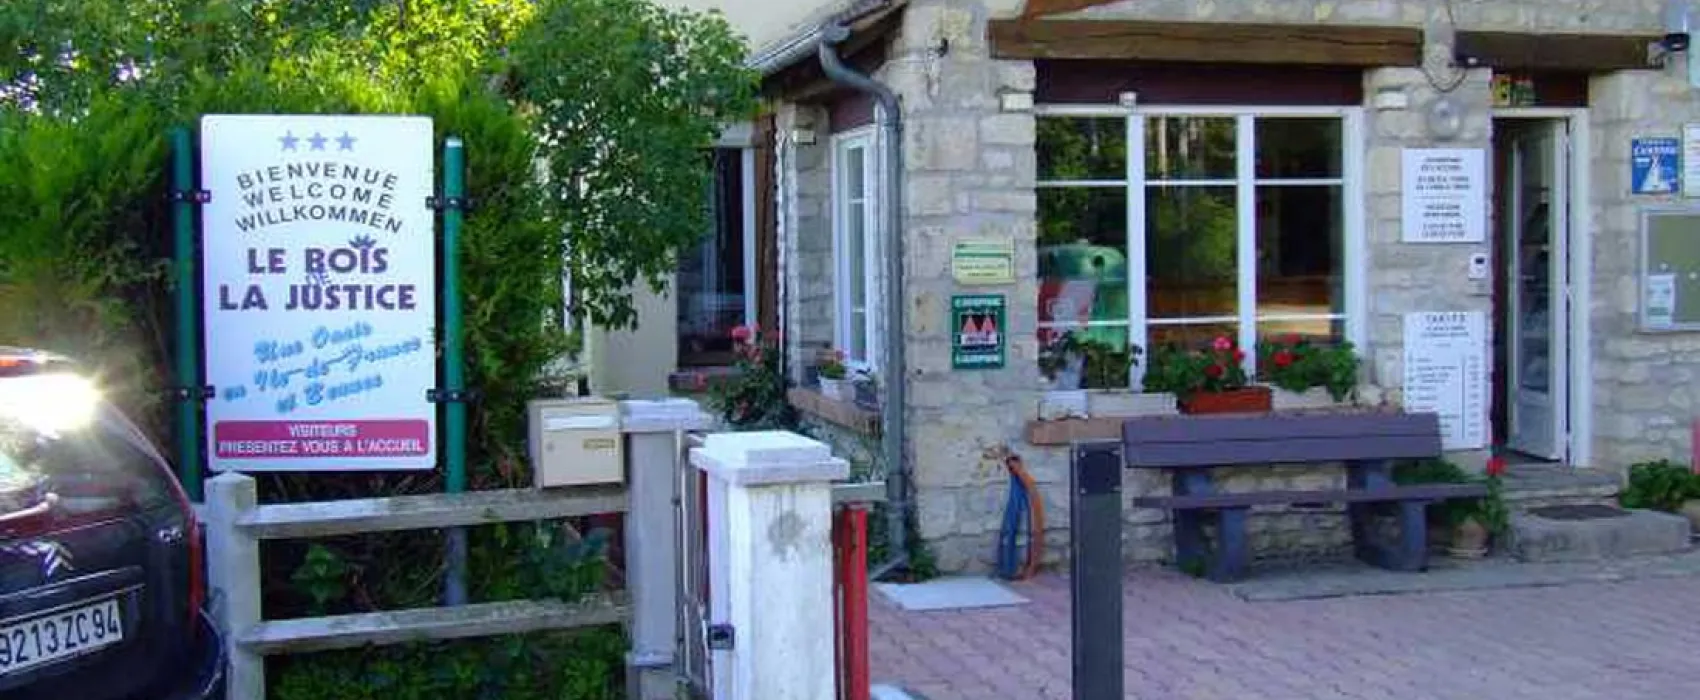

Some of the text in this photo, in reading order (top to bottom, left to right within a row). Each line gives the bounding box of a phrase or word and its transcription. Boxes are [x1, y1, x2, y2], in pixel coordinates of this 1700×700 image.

[235, 161, 399, 192] BIENVENUE
[243, 181, 394, 209] WELCOME
[234, 204, 403, 234] WILLKOMMEN
[247, 247, 389, 274] LE BOIS
[219, 284, 416, 310] LA JUSTICE
[288, 424, 359, 438] VISITEURS
[218, 440, 299, 454] PRESENTEZ
[302, 440, 339, 454] VOUS
[357, 438, 425, 453] L'ACCUEIL
